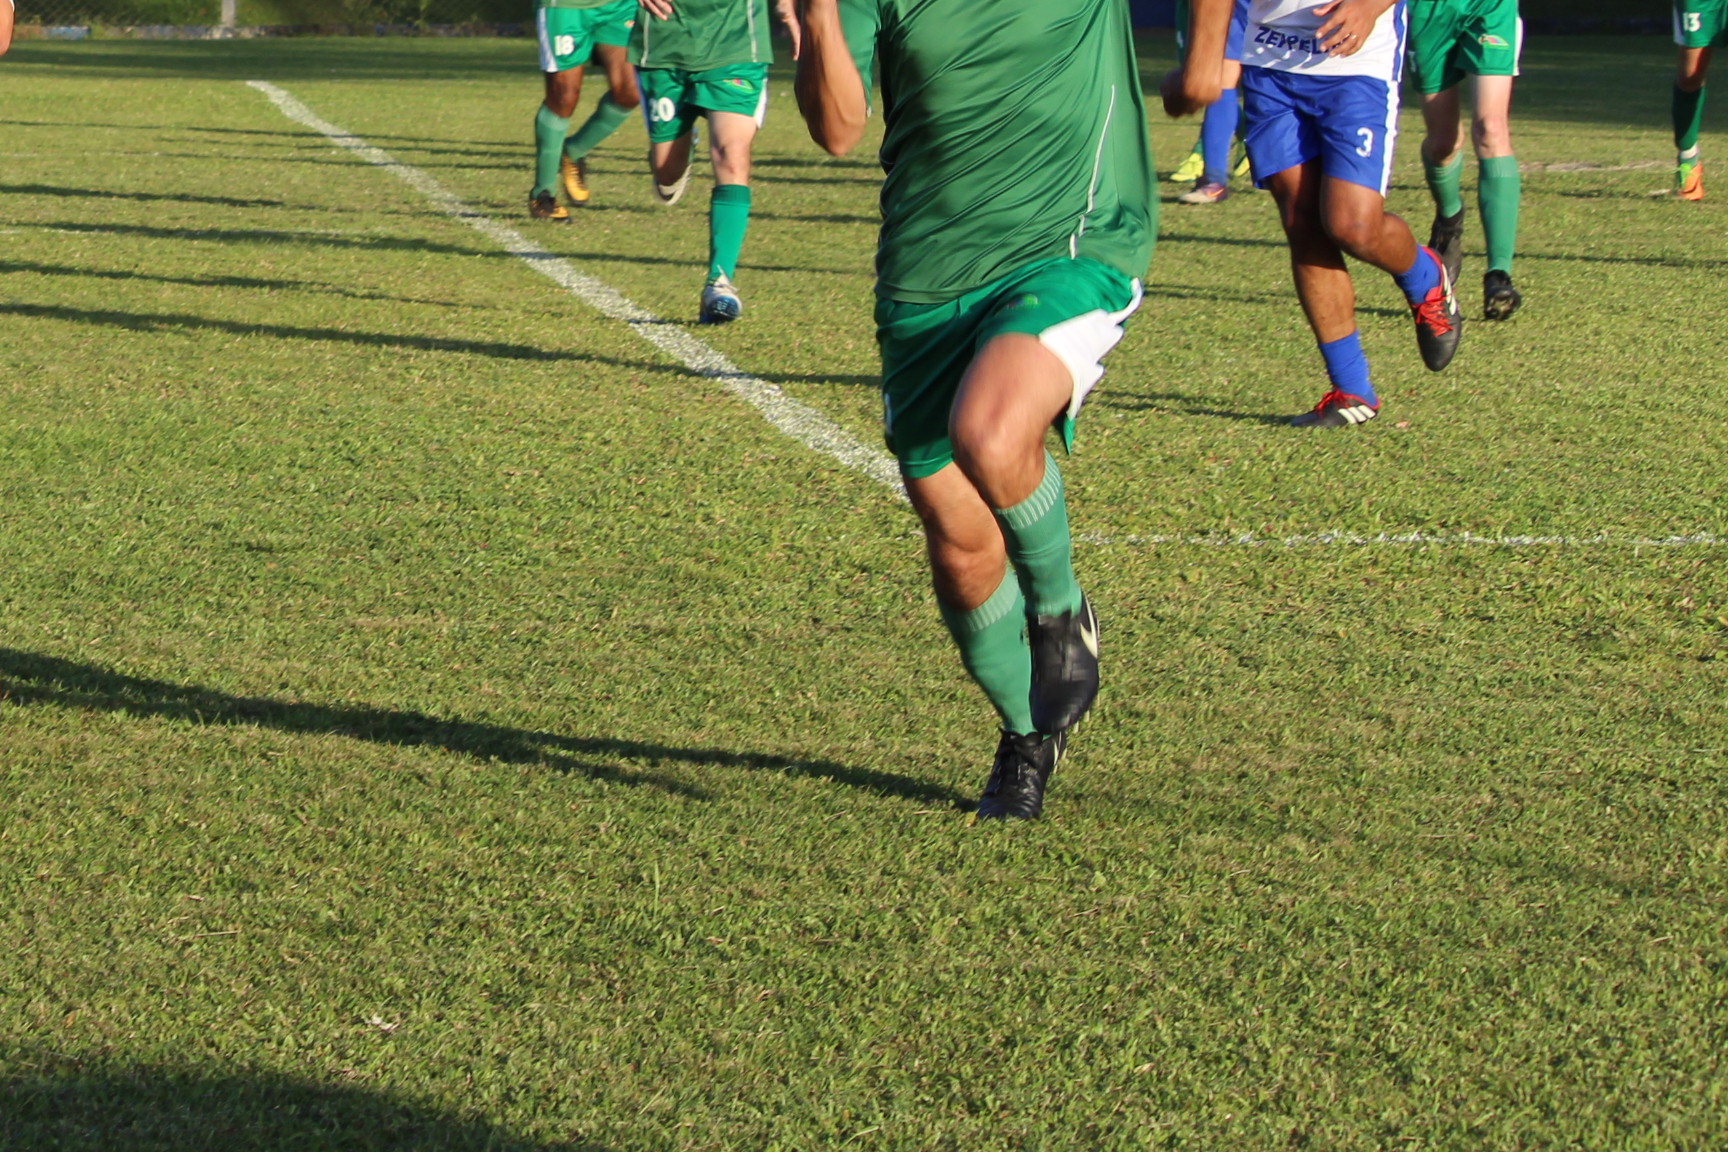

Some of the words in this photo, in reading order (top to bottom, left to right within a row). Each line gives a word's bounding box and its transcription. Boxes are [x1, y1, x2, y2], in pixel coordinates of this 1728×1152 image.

[1683, 12, 1701, 32] 13
[554, 35, 575, 56] 18
[1356, 127, 1373, 158] 3
